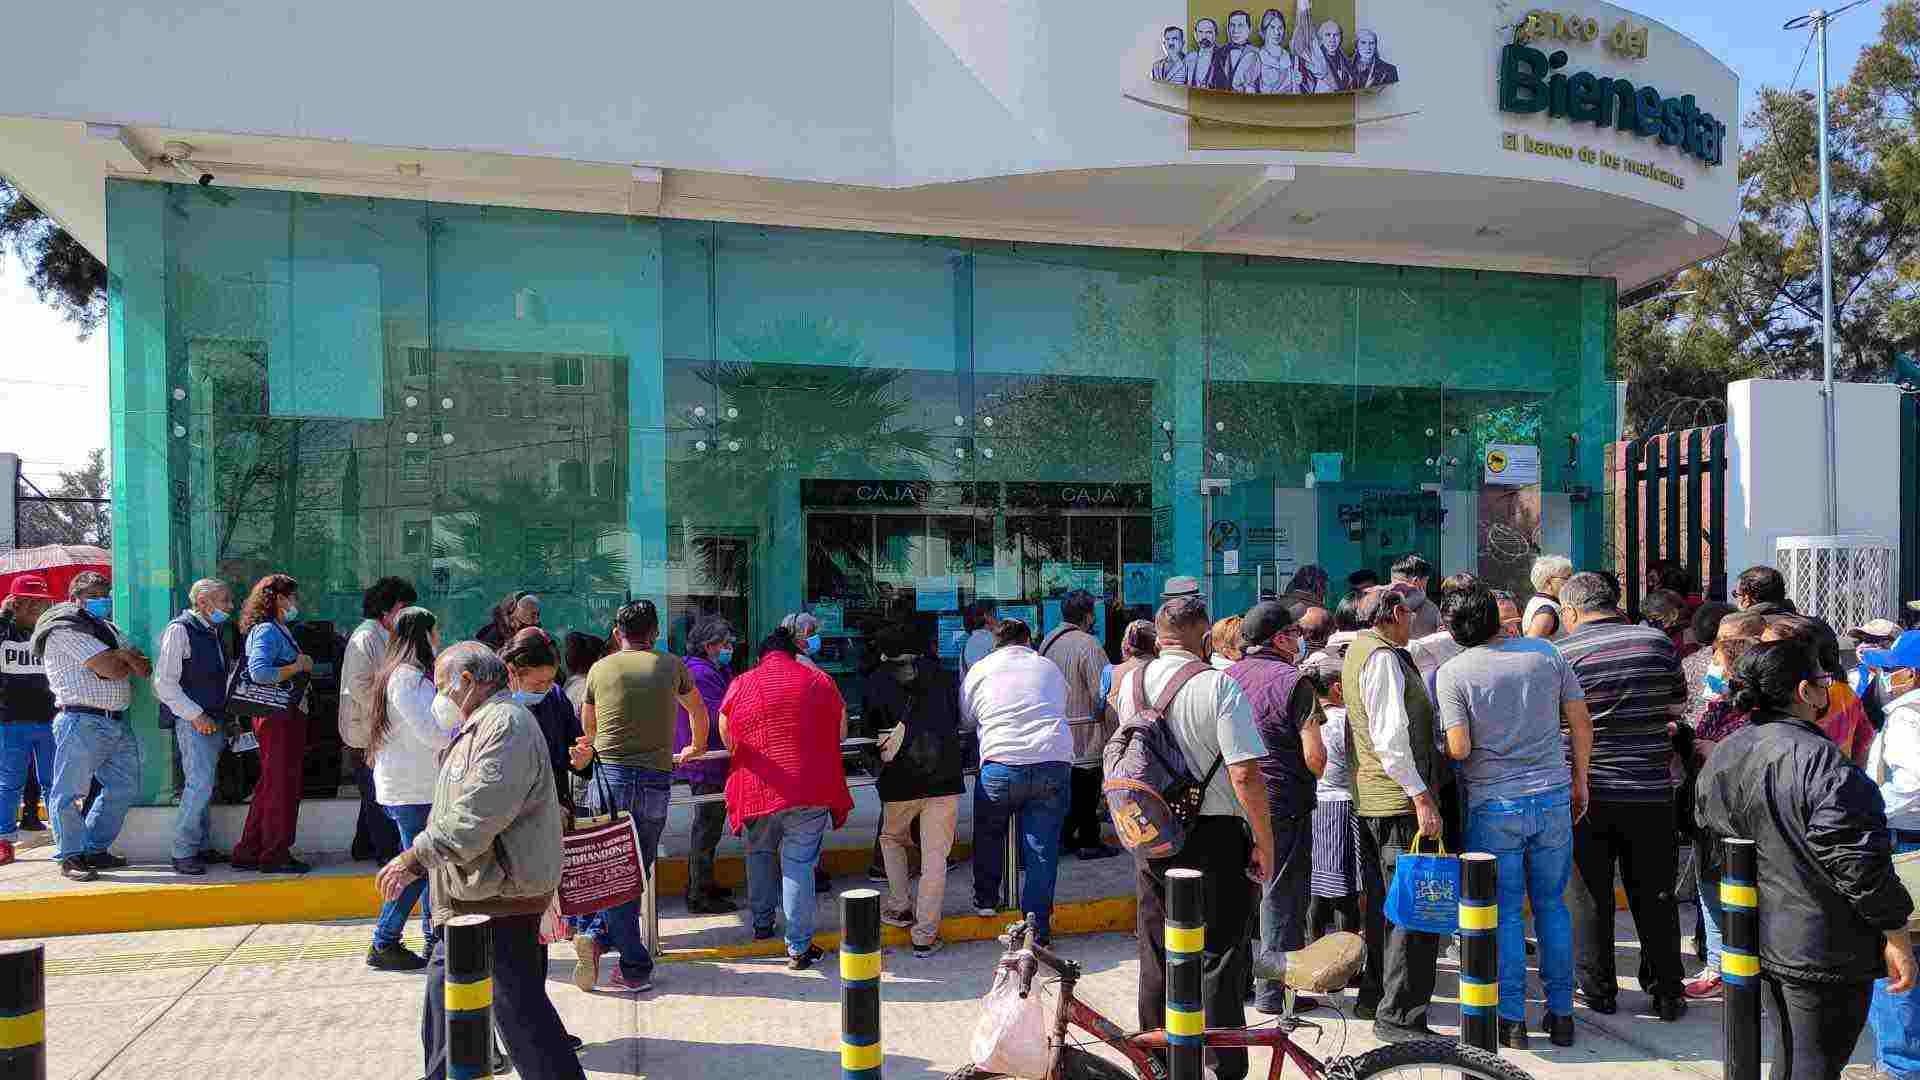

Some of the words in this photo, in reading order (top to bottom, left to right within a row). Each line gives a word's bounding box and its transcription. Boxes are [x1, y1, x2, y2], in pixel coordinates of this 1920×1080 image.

[1516, 10, 1600, 43] anco
[1612, 21, 1649, 60] del
[1500, 44, 1726, 167] Bienestar
[1503, 133, 1520, 151] El
[1524, 135, 1574, 160] banco
[1579, 146, 1598, 164] de
[1601, 150, 1622, 168] los
[1624, 158, 1685, 190] mexicanos
[856, 485, 915, 502] CAJA
[1061, 487, 1117, 504] CAJA
